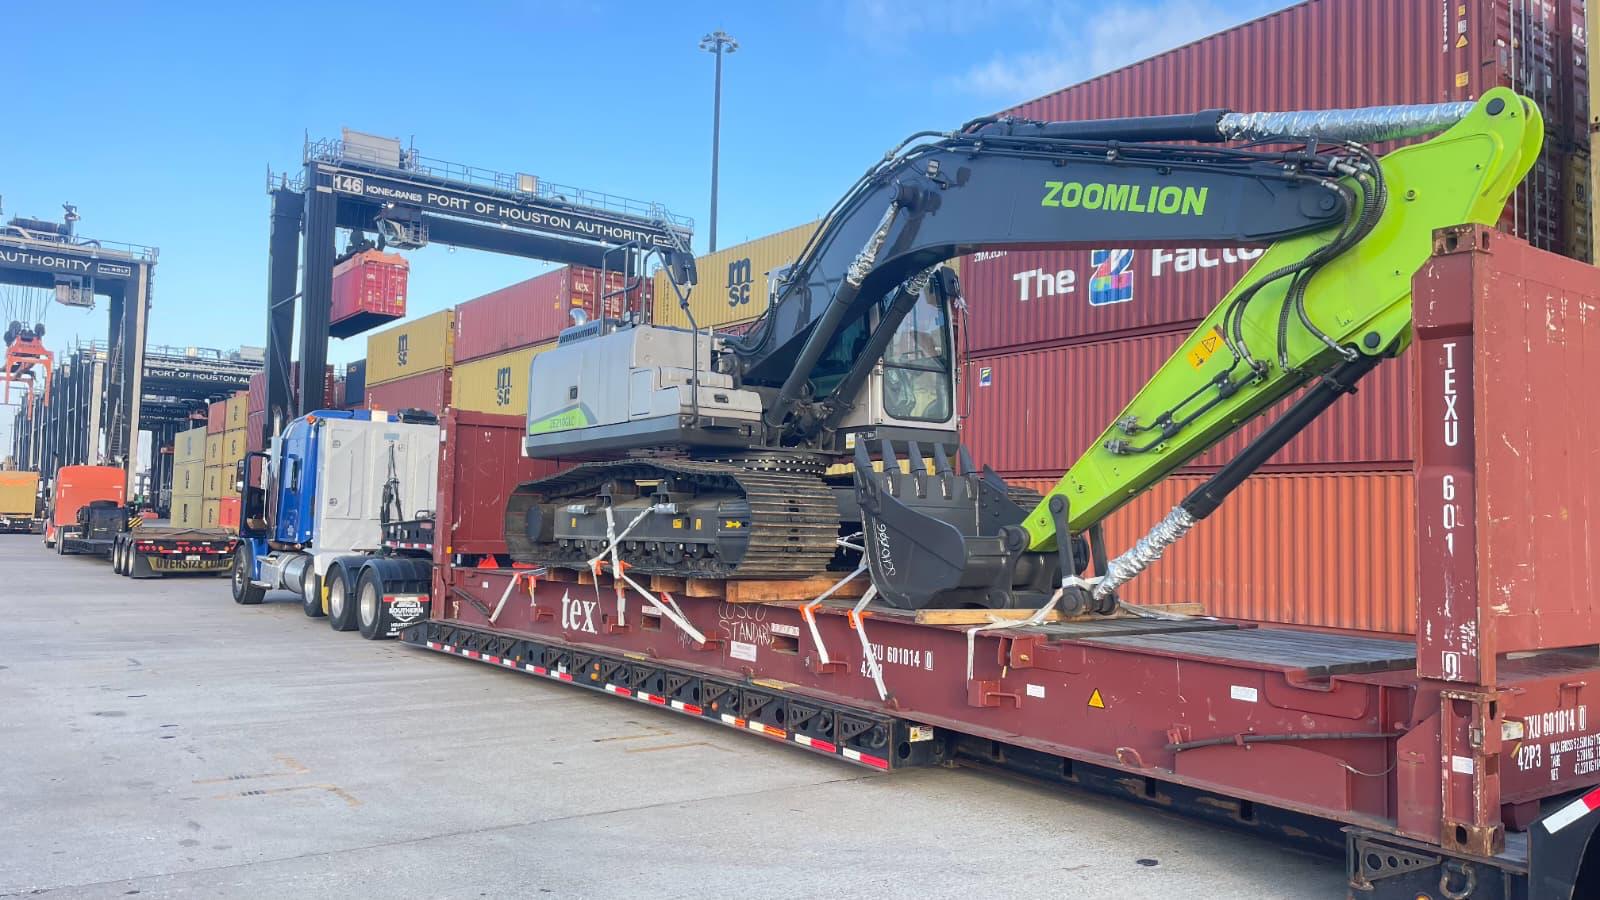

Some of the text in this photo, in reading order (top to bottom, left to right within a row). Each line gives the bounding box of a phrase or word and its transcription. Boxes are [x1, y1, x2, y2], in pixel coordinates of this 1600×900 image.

[334, 175, 362, 192] 146
[366, 184, 423, 203] KONECRANES
[1041, 180, 1209, 216] ZOOMLION
[427, 192, 652, 244] PORT OF HOUSTON AUTHORITY
[0, 250, 92, 272] AUTHORITY
[1012, 267, 1076, 302] The
[151, 369, 176, 378] PORT
[193, 373, 237, 382] HOUSTON
[156, 560, 200, 569] OVERSIZE
[887, 646, 920, 667] 601014
[1543, 708, 1575, 736] 601014
[1518, 744, 1541, 772] 42P3
